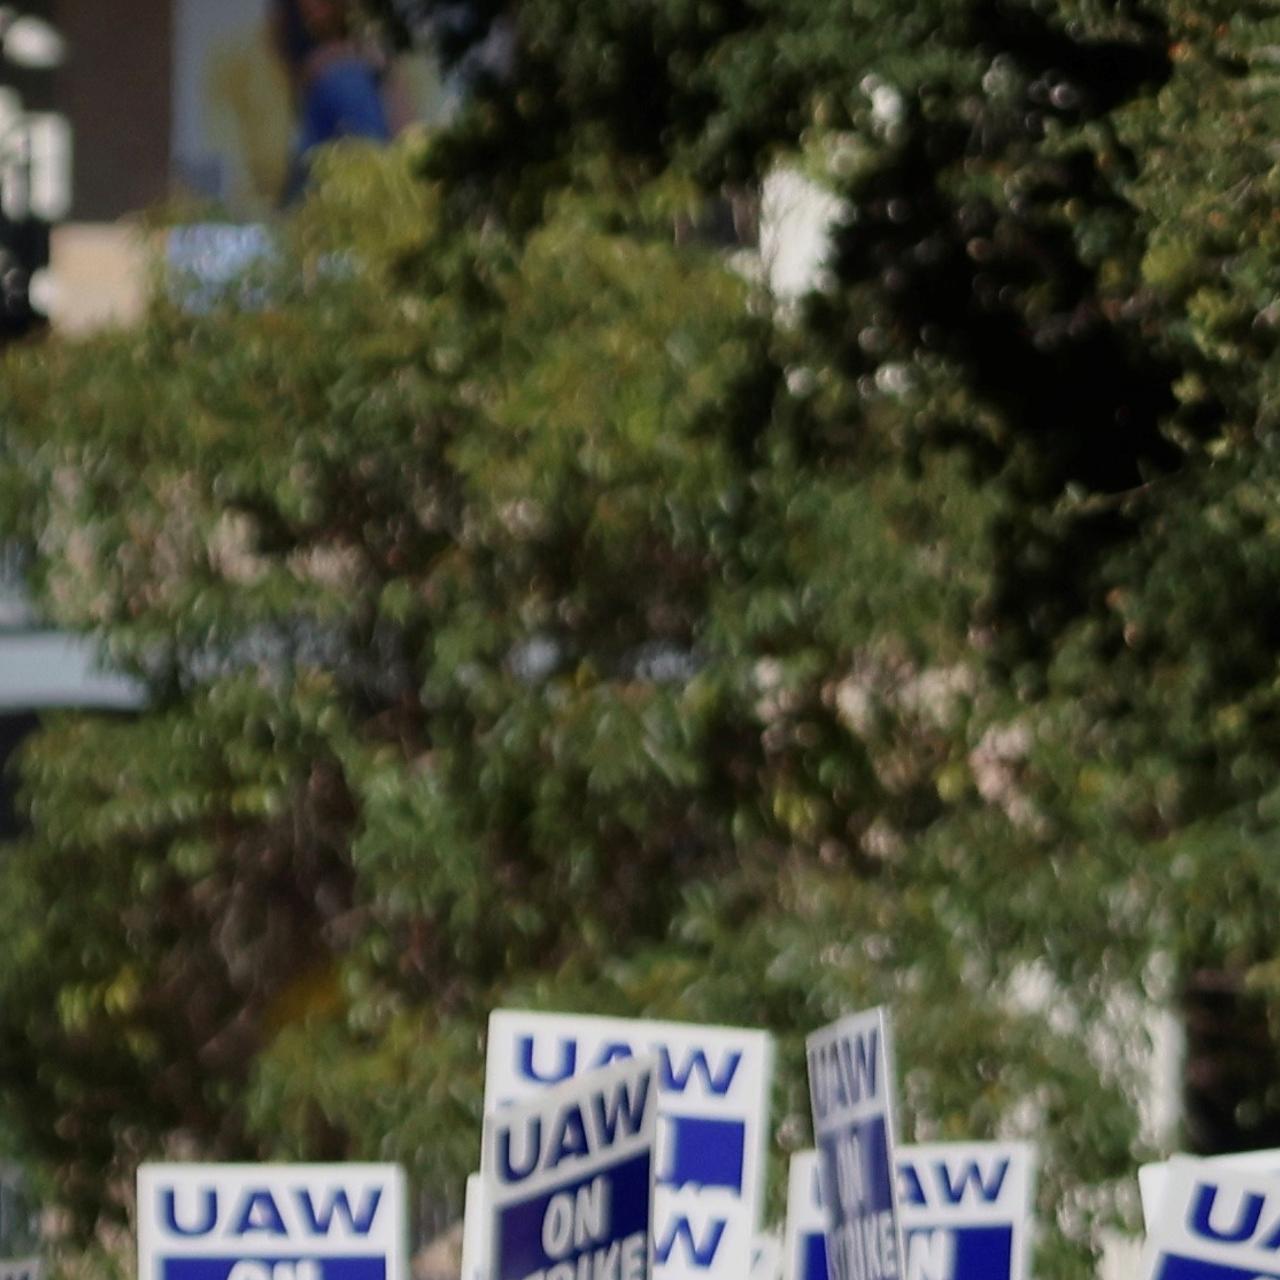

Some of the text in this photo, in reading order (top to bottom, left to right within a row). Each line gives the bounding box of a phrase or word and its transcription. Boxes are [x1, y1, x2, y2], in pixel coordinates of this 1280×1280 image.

[518, 1034, 743, 1098] UW
[501, 1068, 655, 1186] UAW
[156, 1184, 384, 1240] UAW
[541, 1174, 612, 1260] ON
